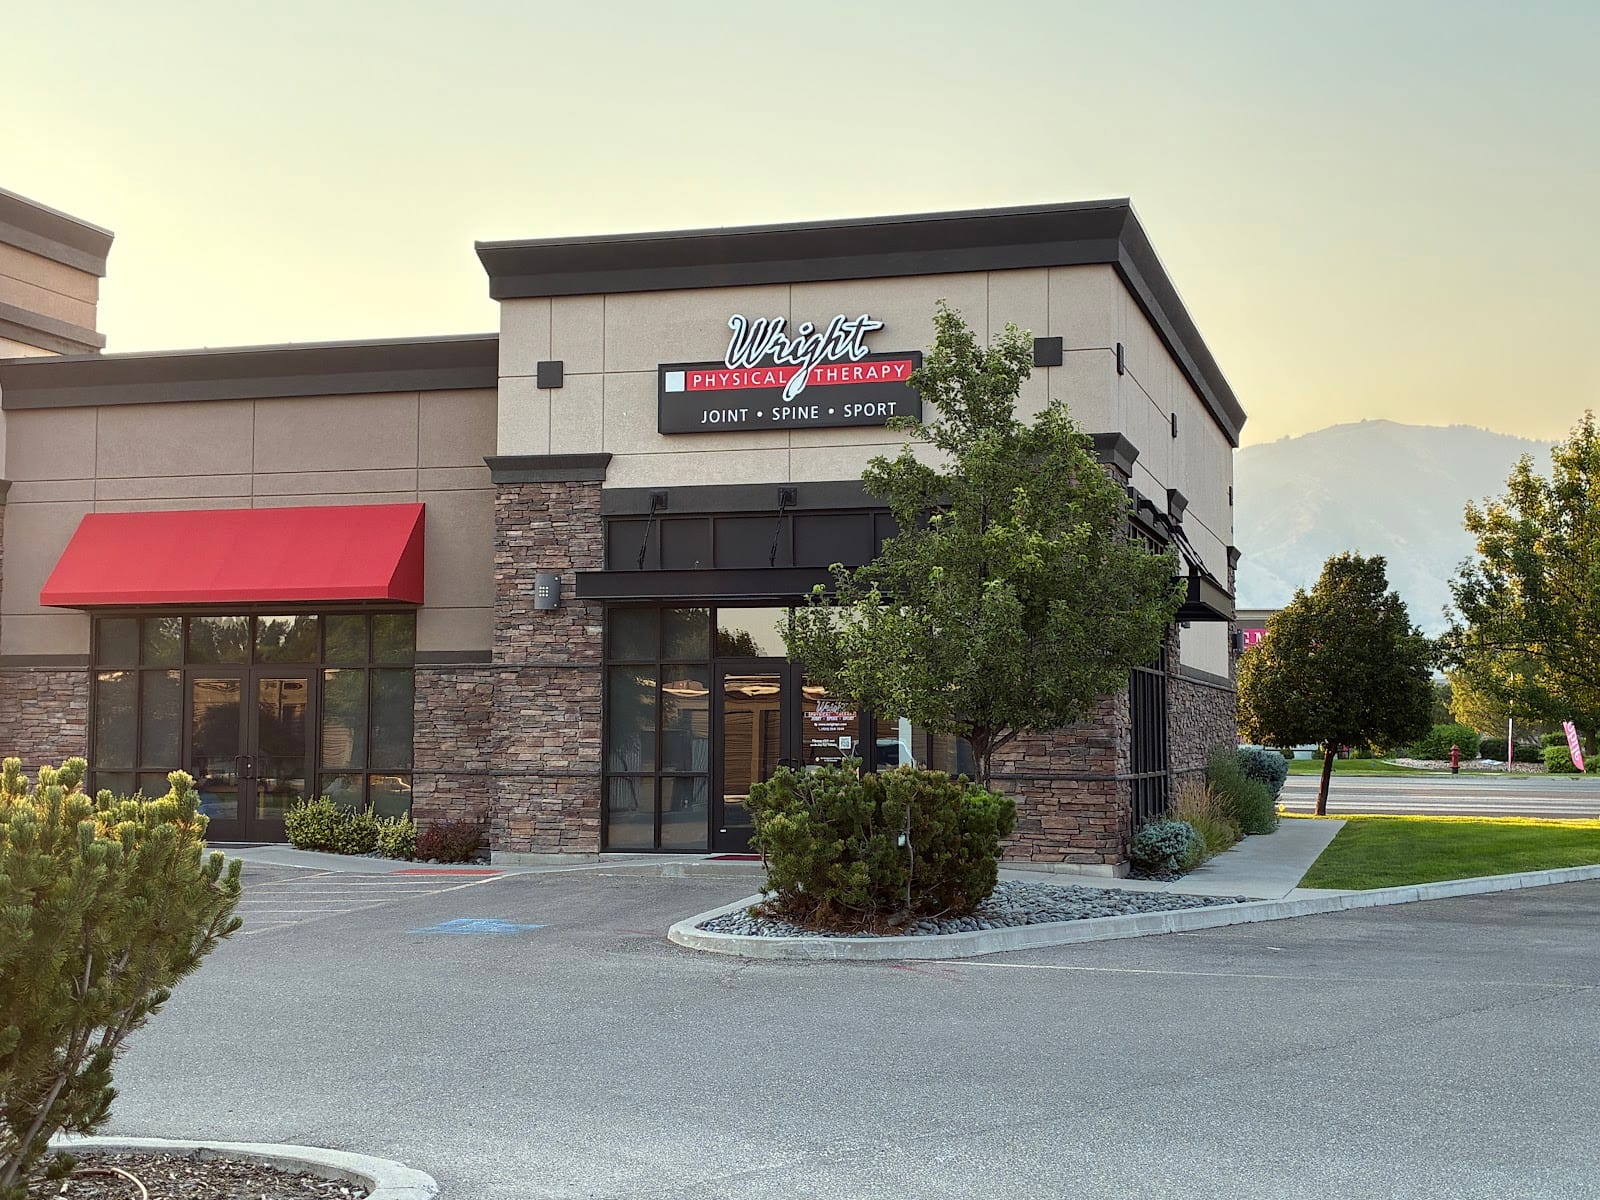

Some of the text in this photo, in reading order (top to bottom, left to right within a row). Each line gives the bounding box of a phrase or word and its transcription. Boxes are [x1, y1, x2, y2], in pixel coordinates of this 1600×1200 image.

[725, 314, 883, 401] Wright
[692, 364, 905, 388] PHYSICAL THERAPY
[701, 402, 897, 424] JOINT SPINE SPORT
